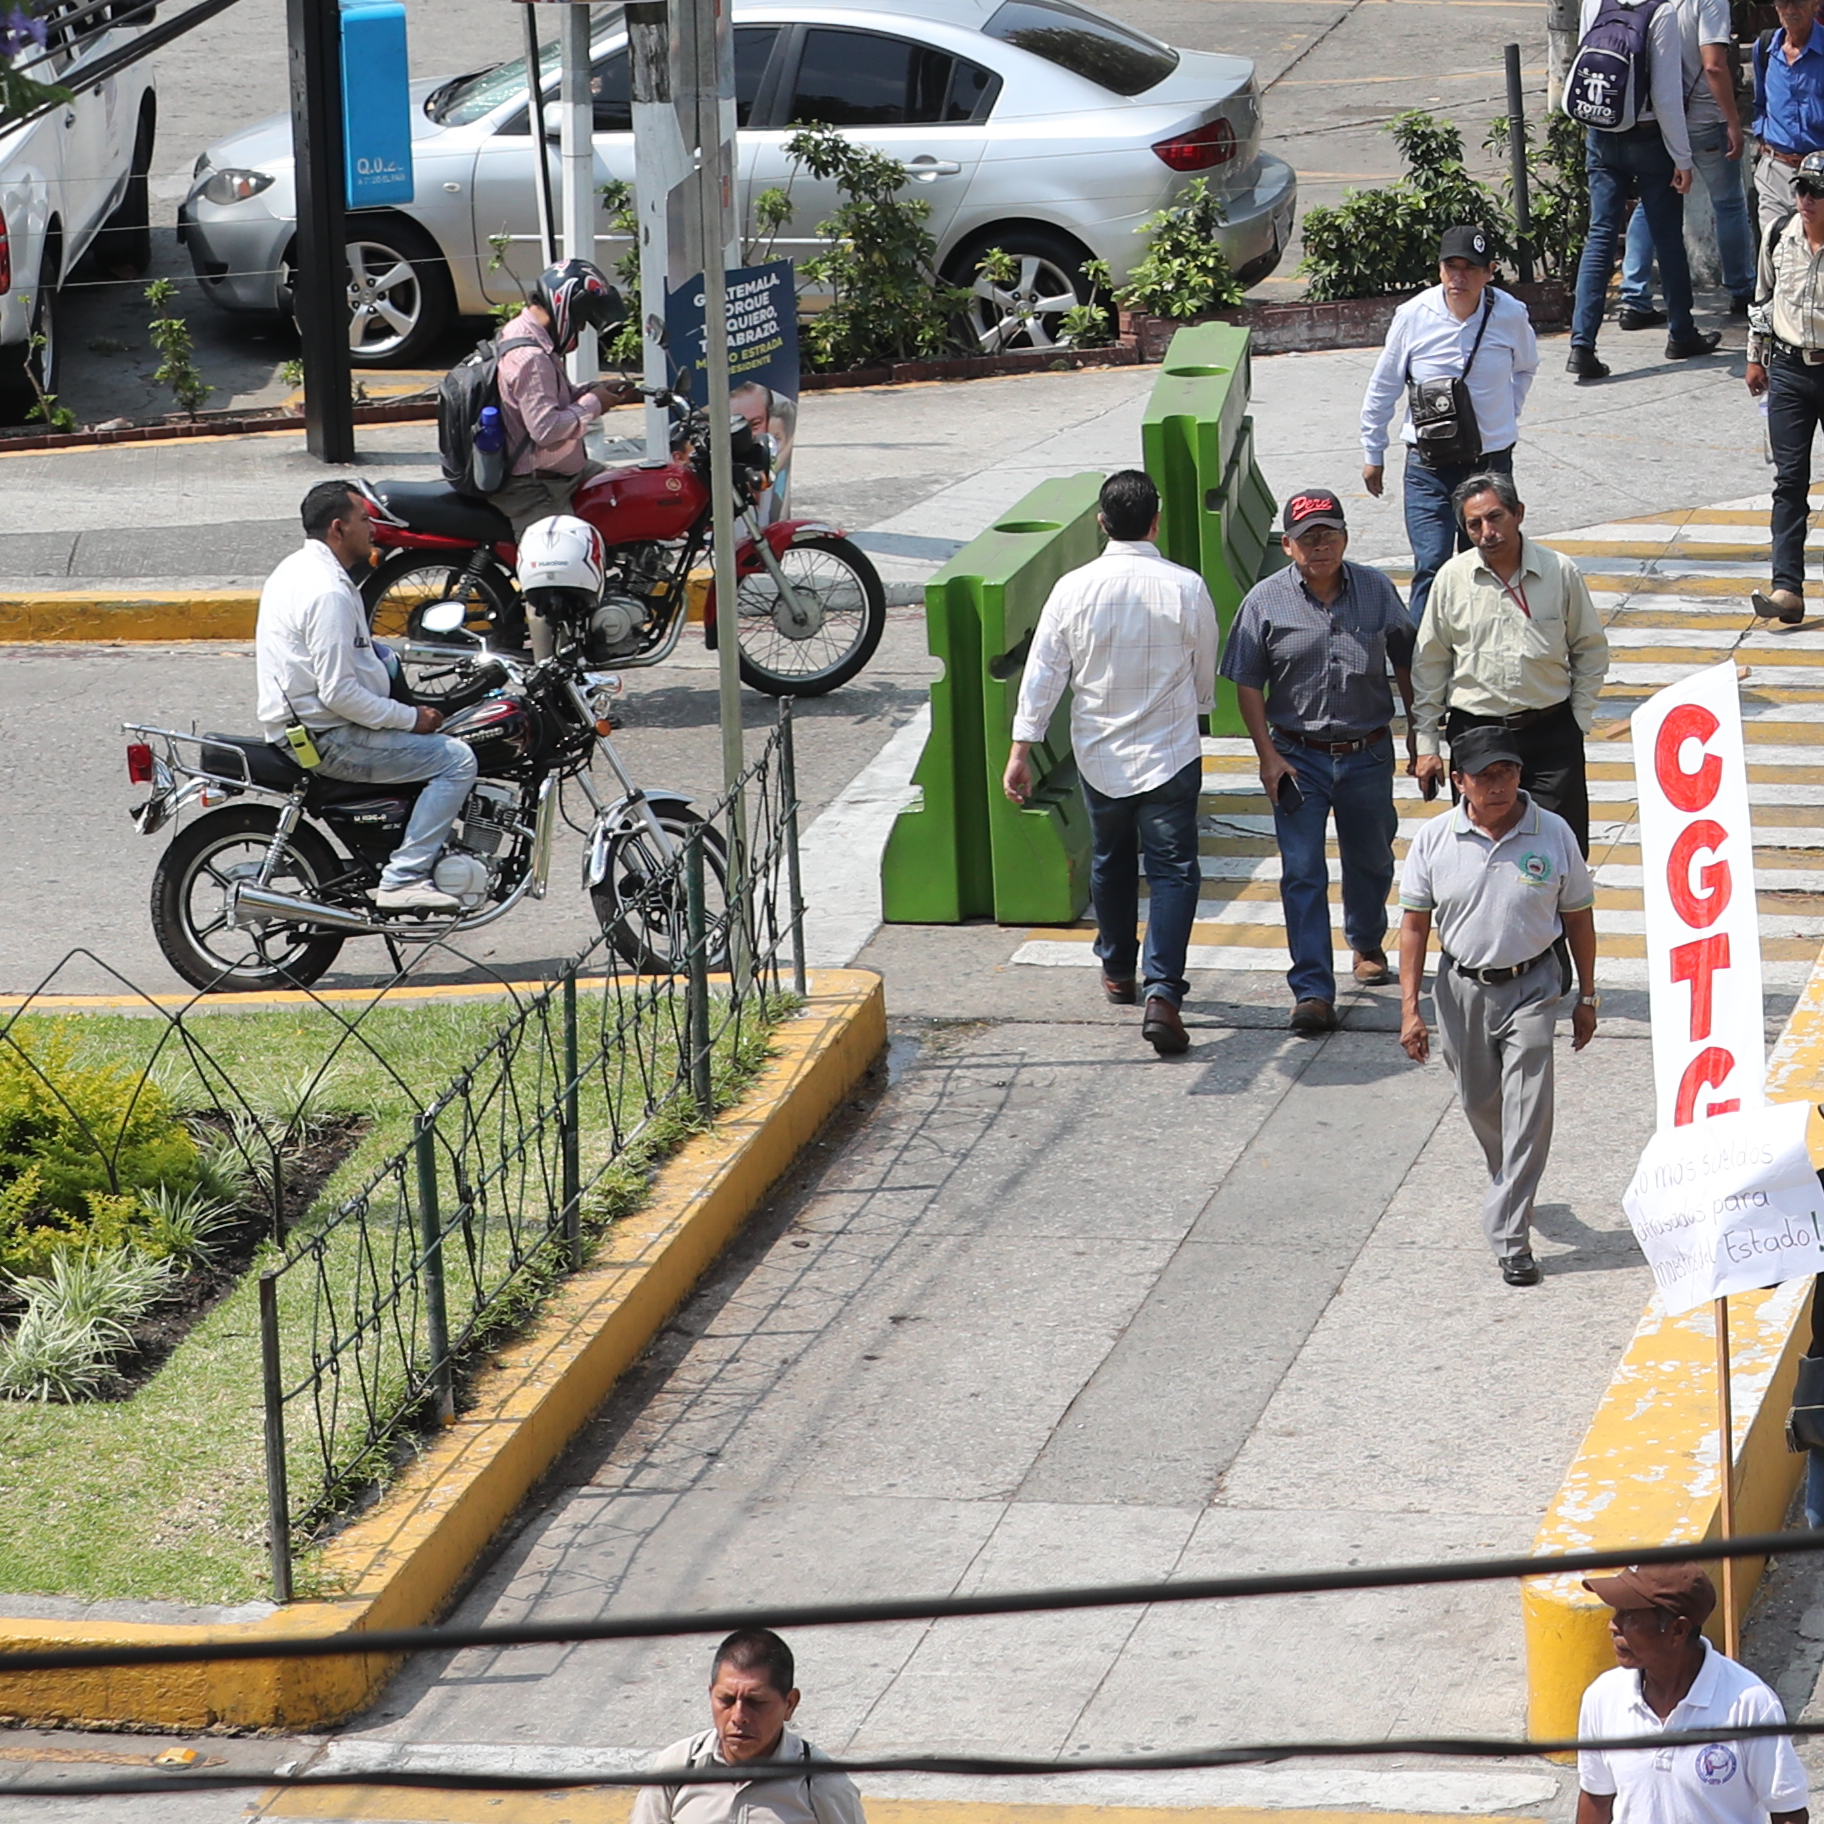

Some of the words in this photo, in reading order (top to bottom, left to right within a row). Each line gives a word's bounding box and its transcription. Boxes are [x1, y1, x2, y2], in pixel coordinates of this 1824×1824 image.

[1576, 99, 1612, 117] TOTTO
[741, 336, 784, 360] ESTRADA
[1712, 1189, 1771, 1225] para
